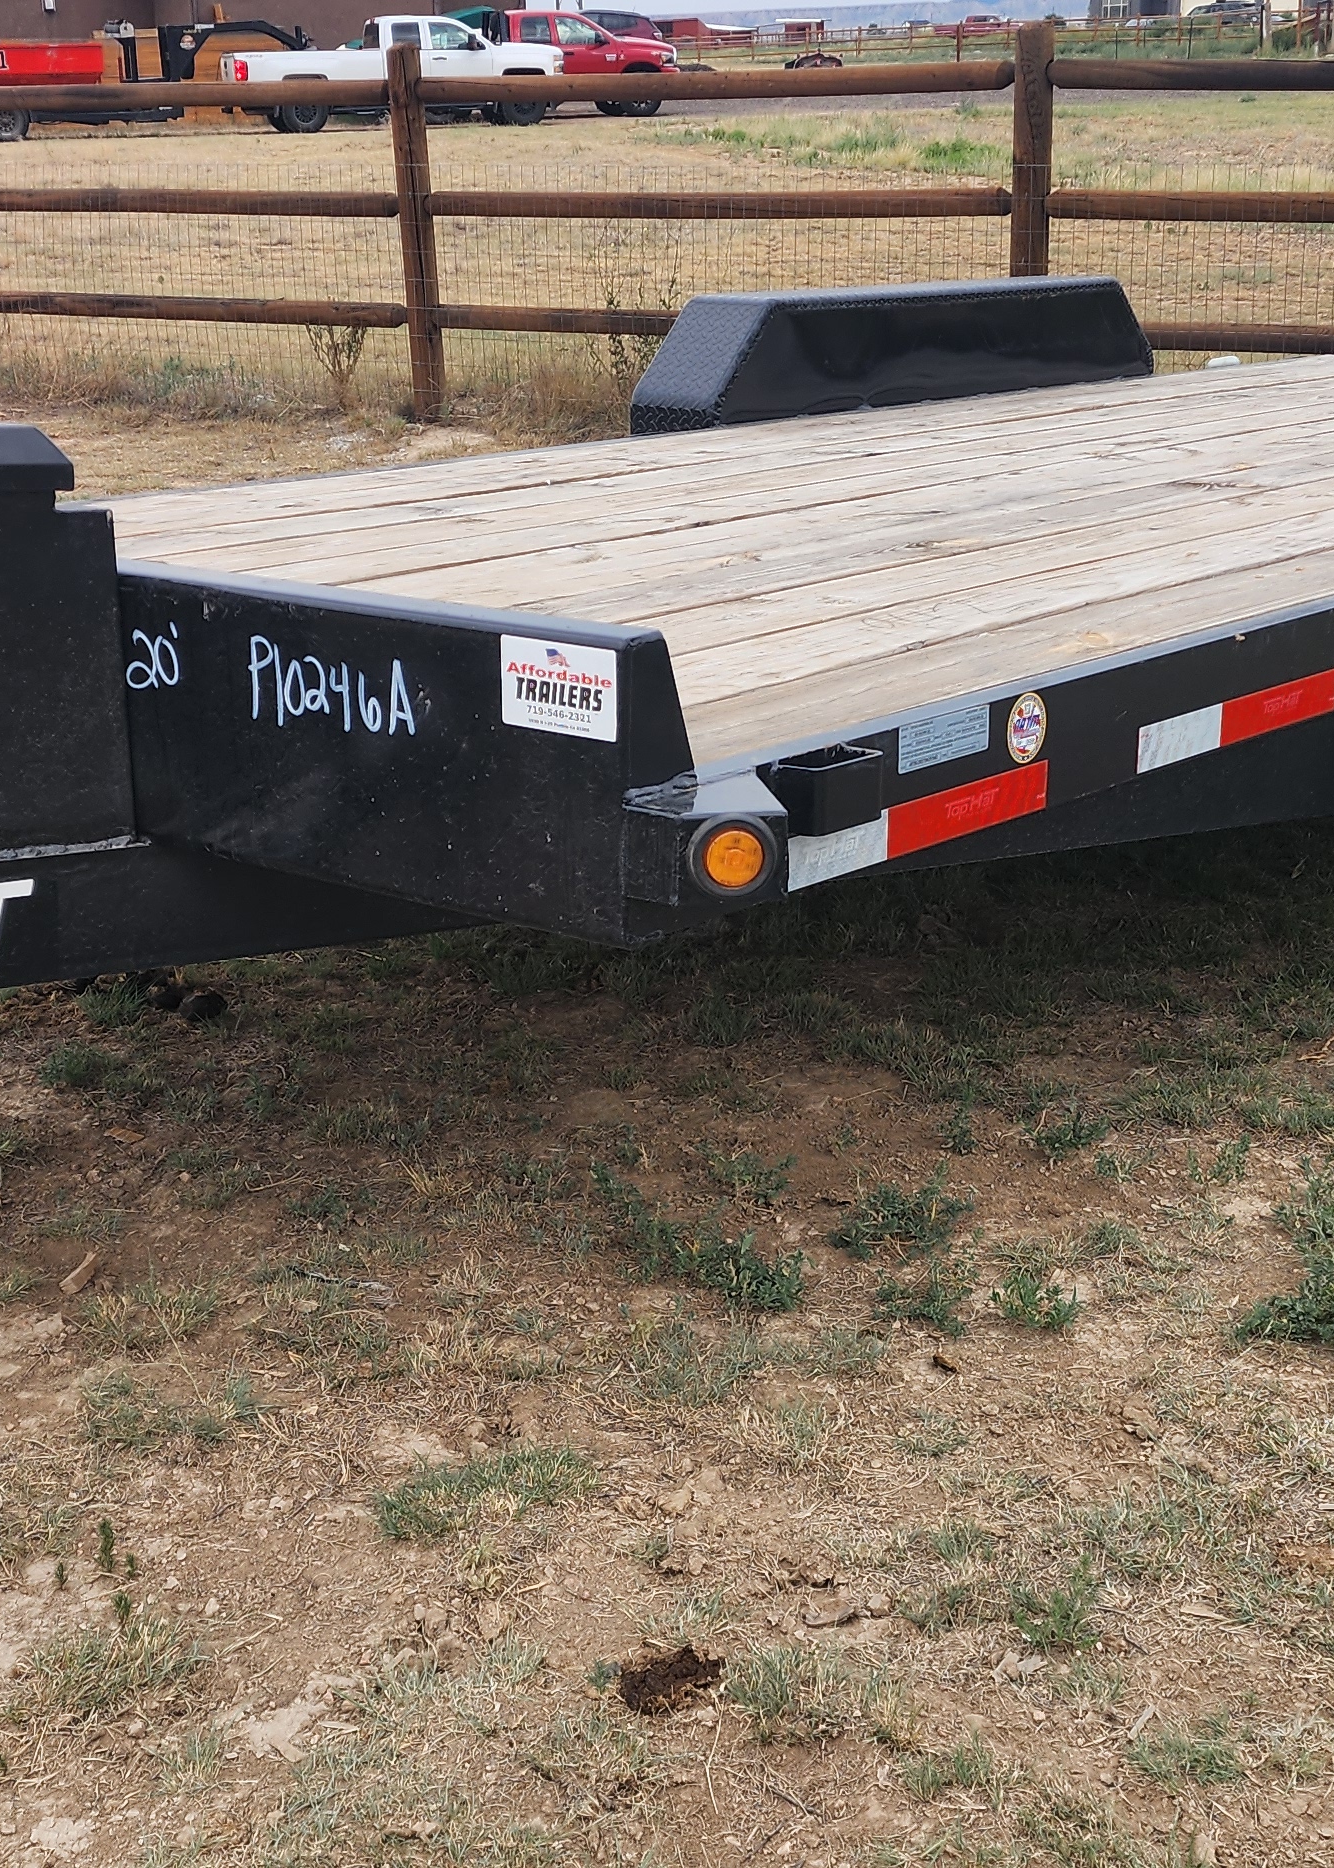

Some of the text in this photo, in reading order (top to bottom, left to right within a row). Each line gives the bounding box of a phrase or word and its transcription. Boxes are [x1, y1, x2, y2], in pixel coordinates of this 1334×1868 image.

[248, 634, 416, 736] P10246A
[506, 661, 613, 689] Affordable
[515, 676, 603, 712] TRAILERS
[526, 705, 592, 724] 719-546-2321
